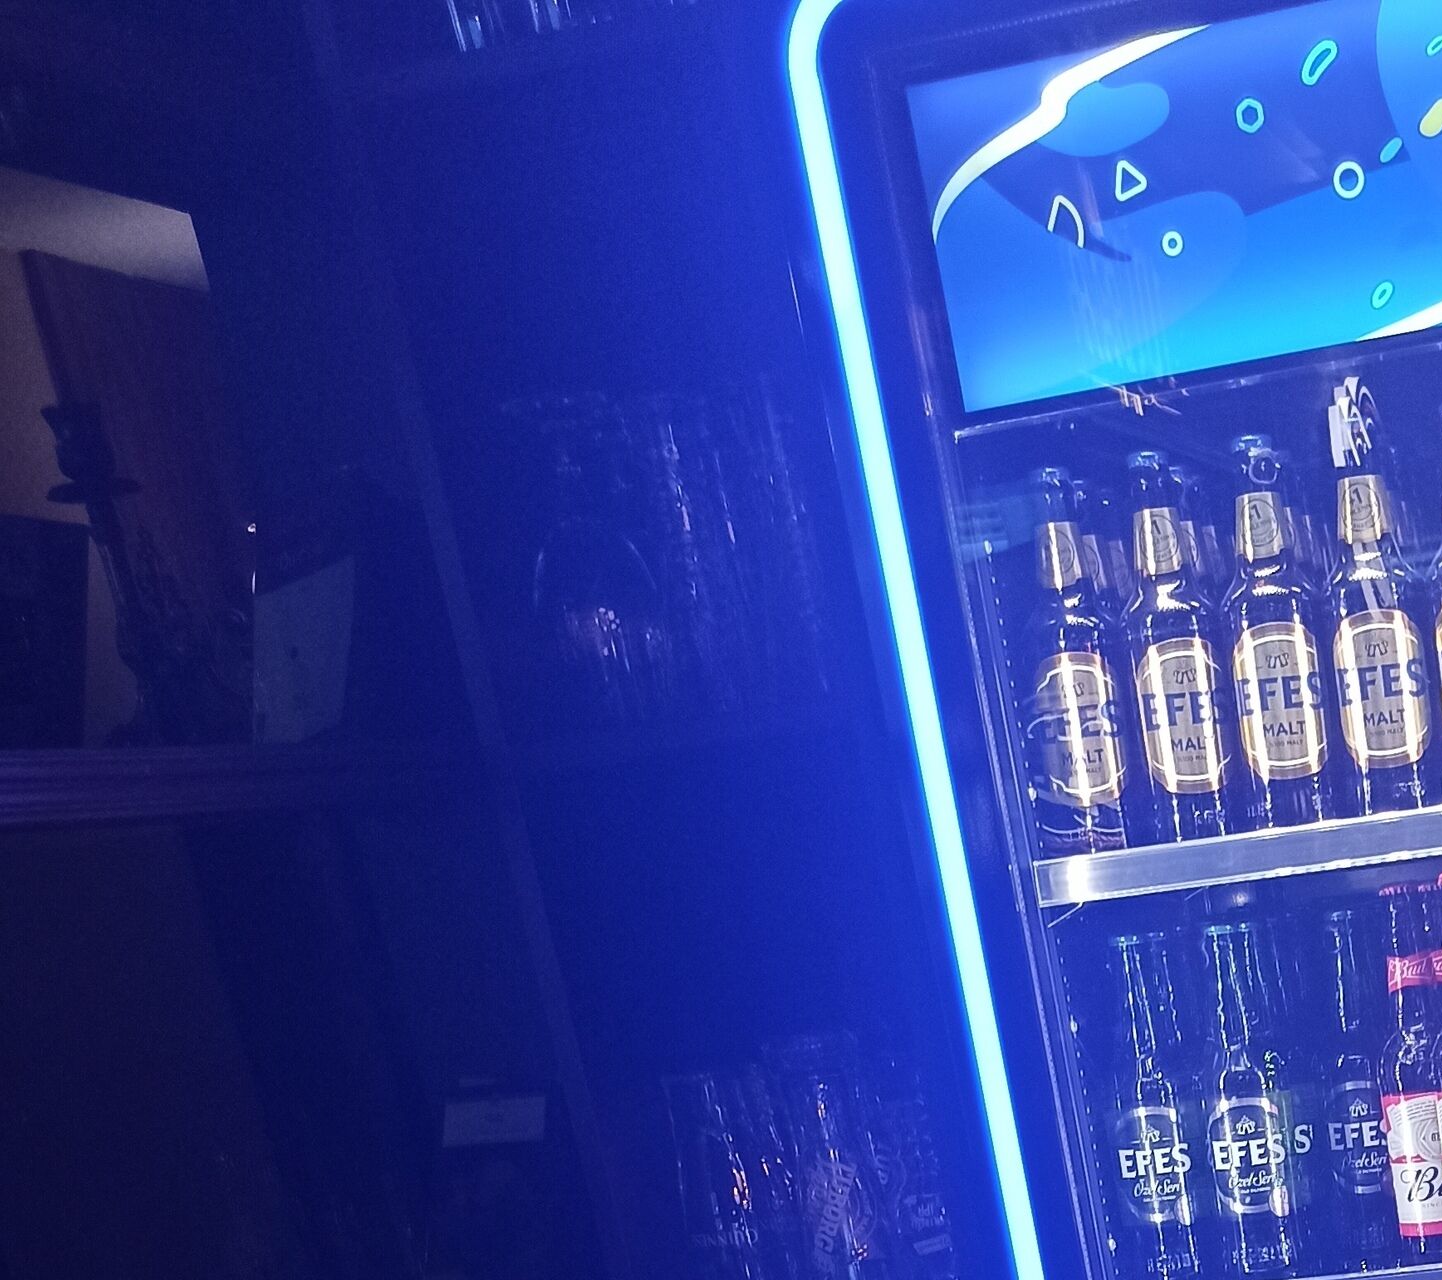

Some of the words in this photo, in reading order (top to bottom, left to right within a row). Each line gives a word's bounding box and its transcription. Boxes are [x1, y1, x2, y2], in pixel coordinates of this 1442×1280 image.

[1237, 671, 1324, 717] EFES
[1338, 657, 1428, 707] EFES
[1262, 719, 1307, 738] MALT
[1363, 708, 1406, 729] MALT
[1212, 1132, 1287, 1171] EFES
[1328, 1120, 1387, 1152] EFE
[1118, 1142, 1192, 1179] EFES
